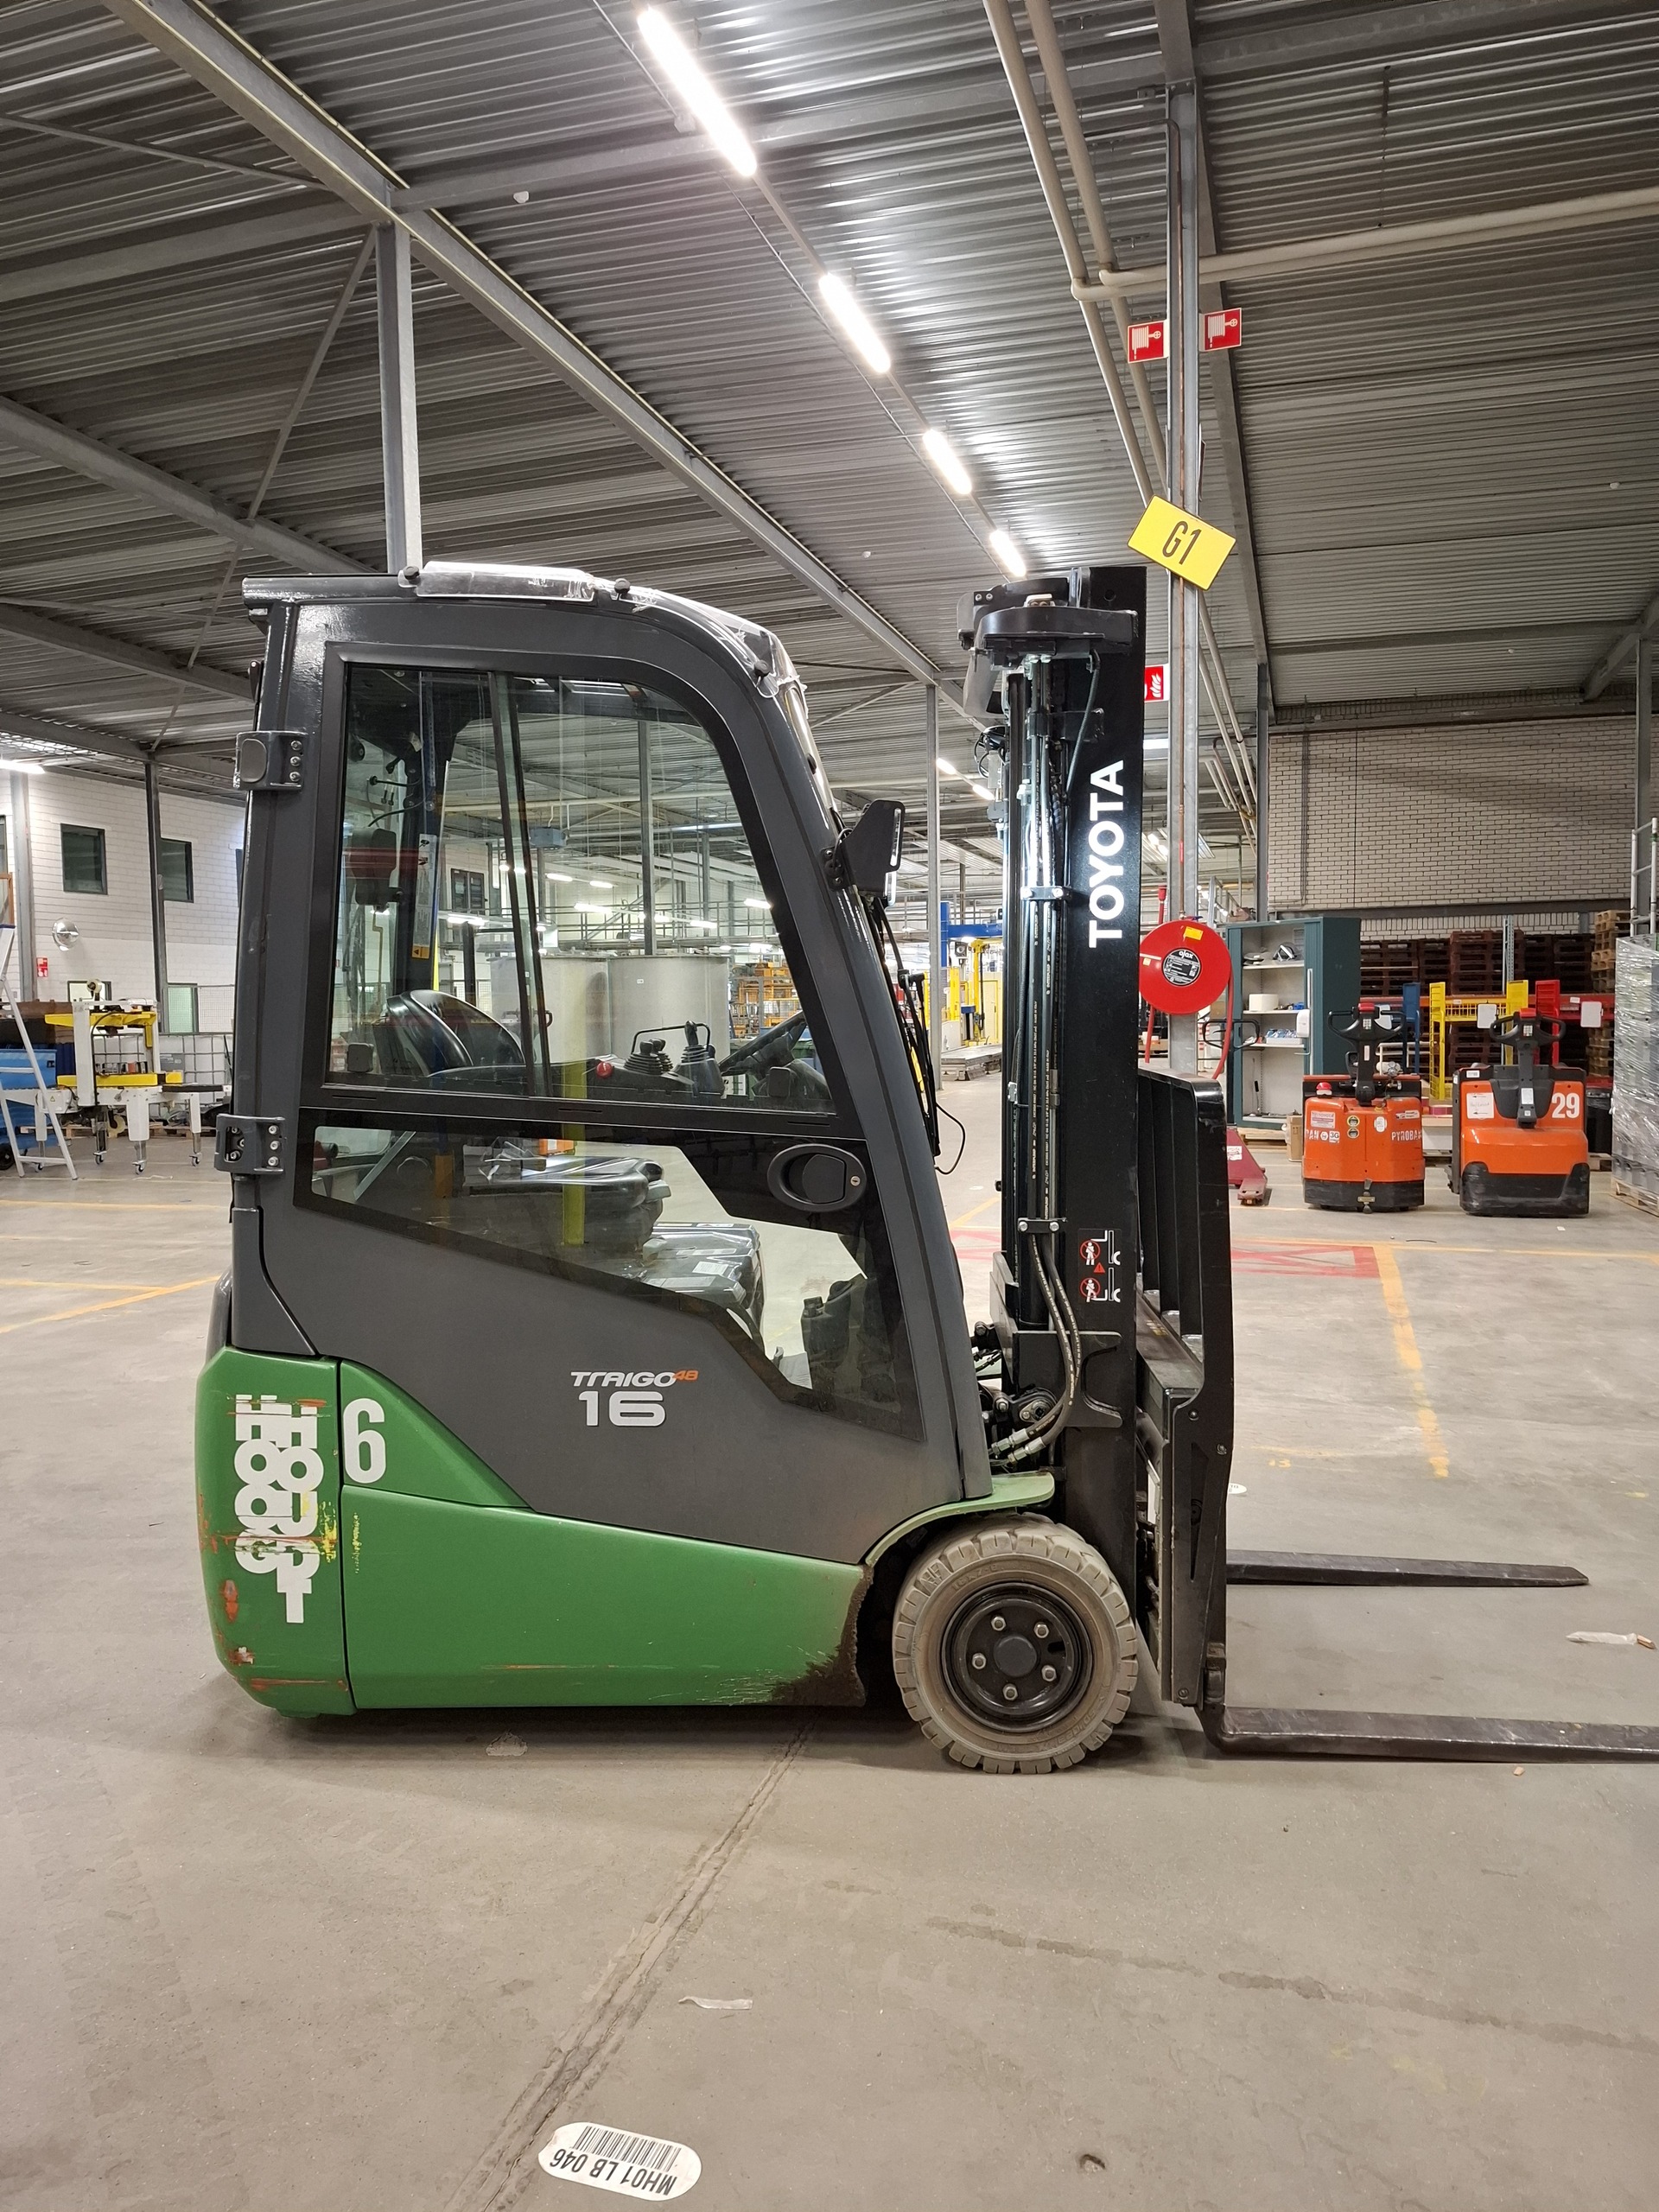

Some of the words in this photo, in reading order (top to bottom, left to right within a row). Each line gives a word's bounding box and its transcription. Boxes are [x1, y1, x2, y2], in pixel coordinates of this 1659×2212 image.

[1162, 520, 1202, 565] G1
[1089, 760, 1125, 949] TOYOTA
[1552, 1092, 1580, 1118] 29
[578, 1390, 665, 1426] 16
[343, 1397, 386, 1484] 6
[550, 2148, 588, 2173] 046
[589, 2158, 619, 2181] LB
[620, 2166, 677, 2196] MH01
